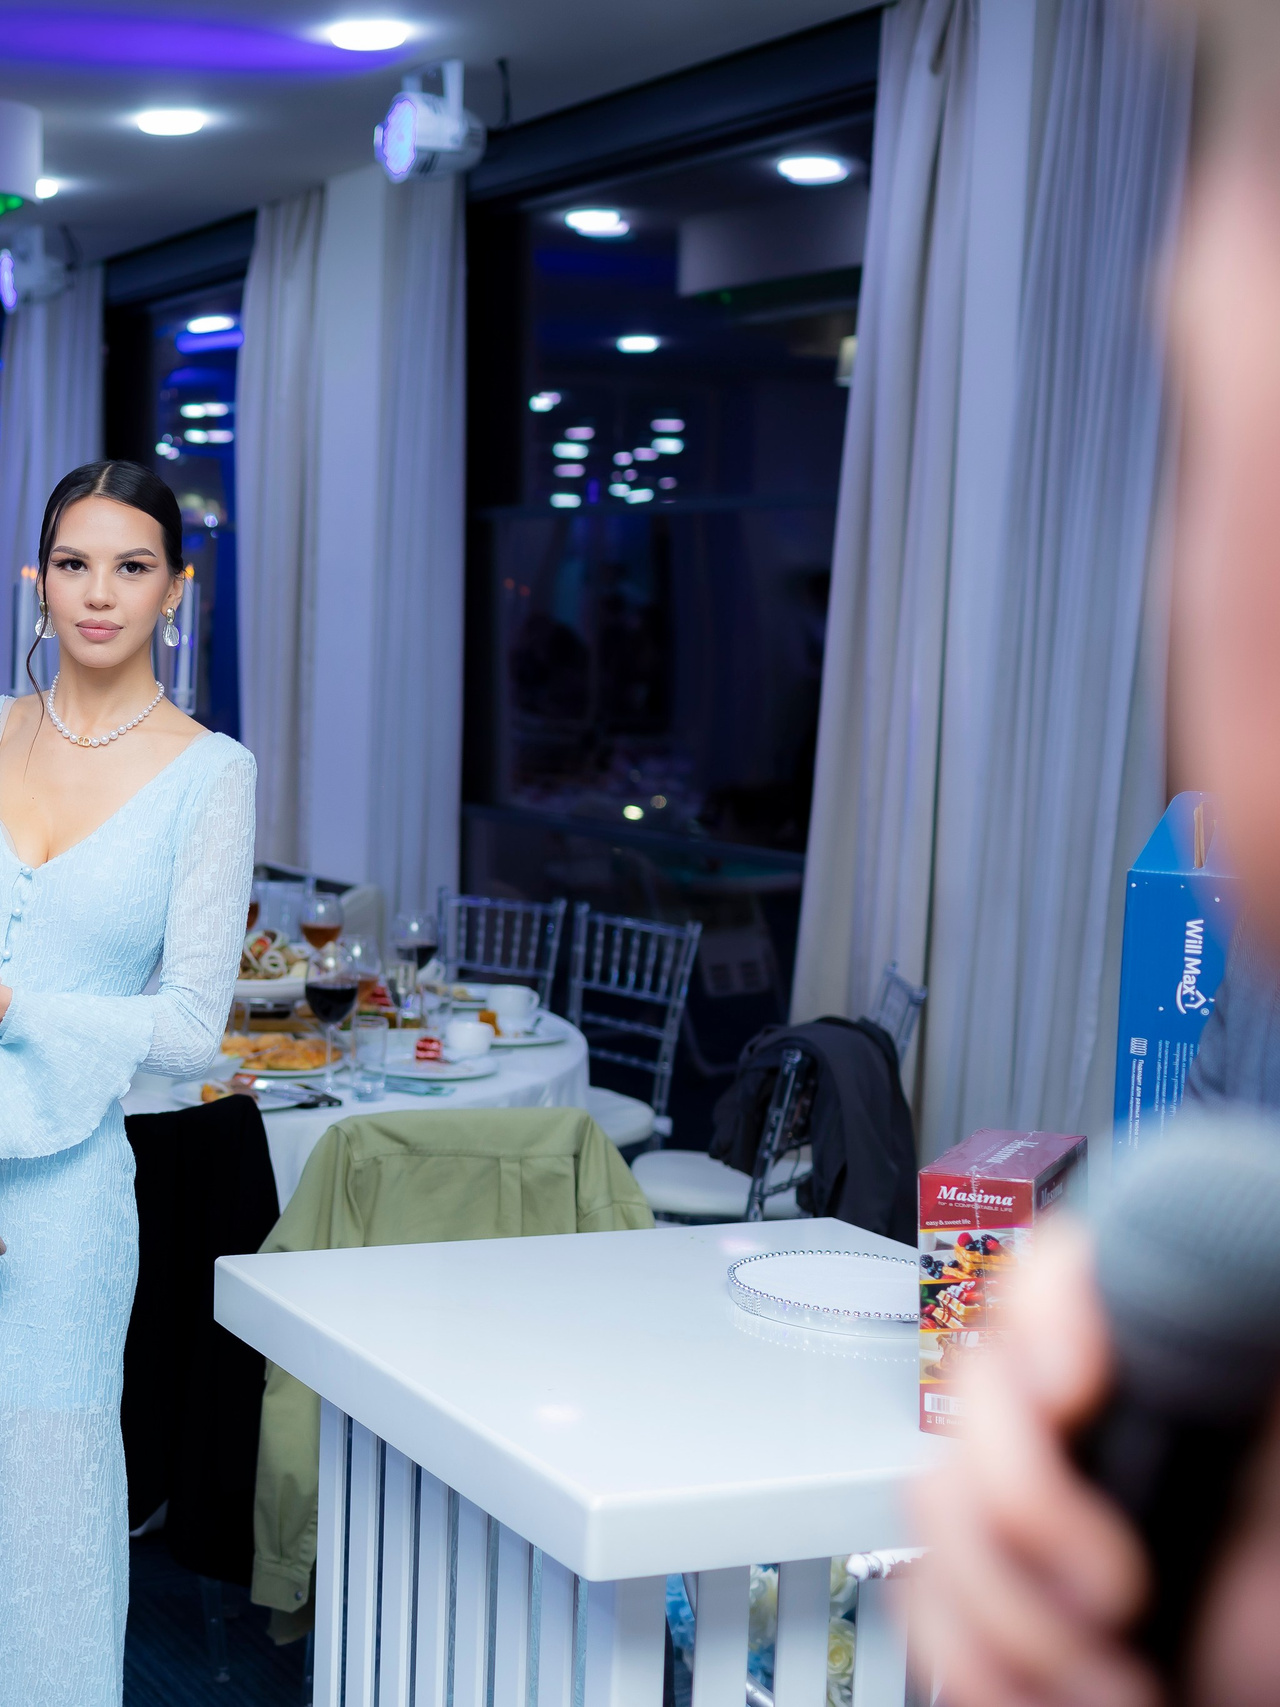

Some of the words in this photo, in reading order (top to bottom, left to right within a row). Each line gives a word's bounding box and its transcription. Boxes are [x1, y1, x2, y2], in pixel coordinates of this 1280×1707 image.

[1185, 919, 1204, 954] Will
[1182, 957, 1202, 995] Max
[937, 1185, 1013, 1206] Masima
